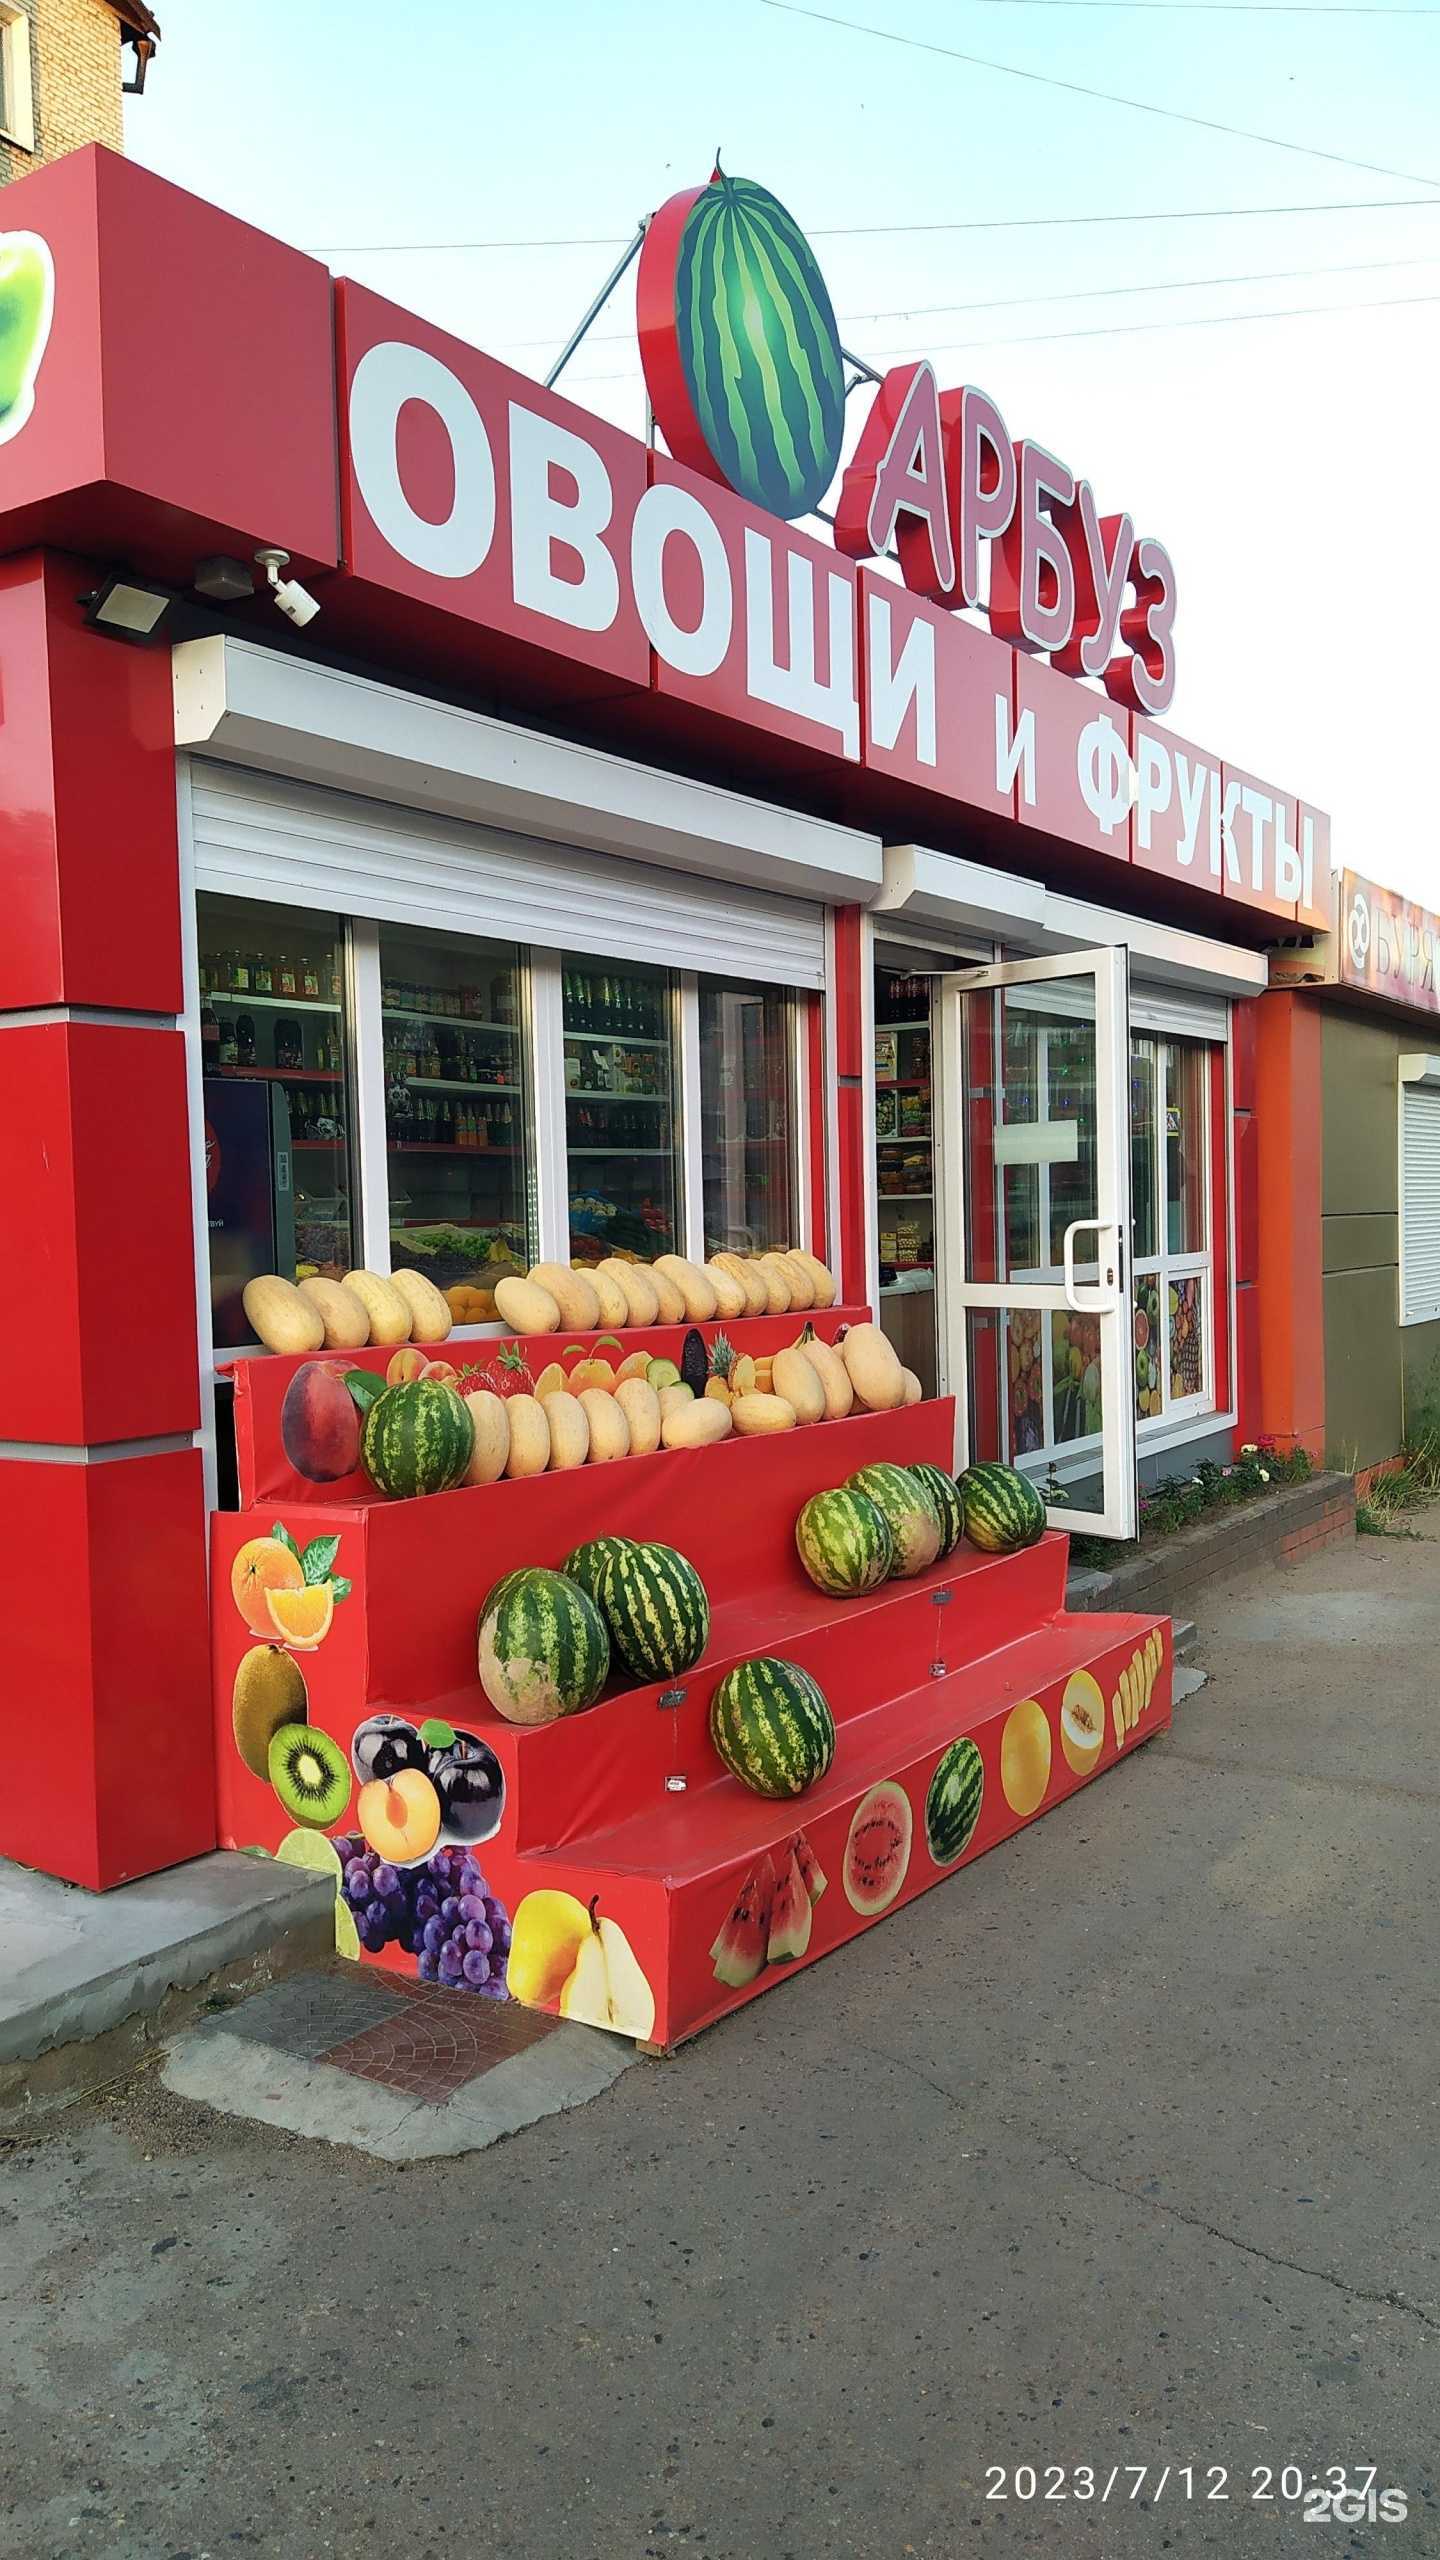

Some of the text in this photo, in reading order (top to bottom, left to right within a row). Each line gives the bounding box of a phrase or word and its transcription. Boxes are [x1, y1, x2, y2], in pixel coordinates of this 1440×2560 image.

[349, 340, 937, 768] ОВОЩИ
[1076, 711, 1314, 909] ФРУКТЫ
[867, 359, 1177, 716] АРБУЗ
[1376, 906, 1440, 994] БУРЯ
